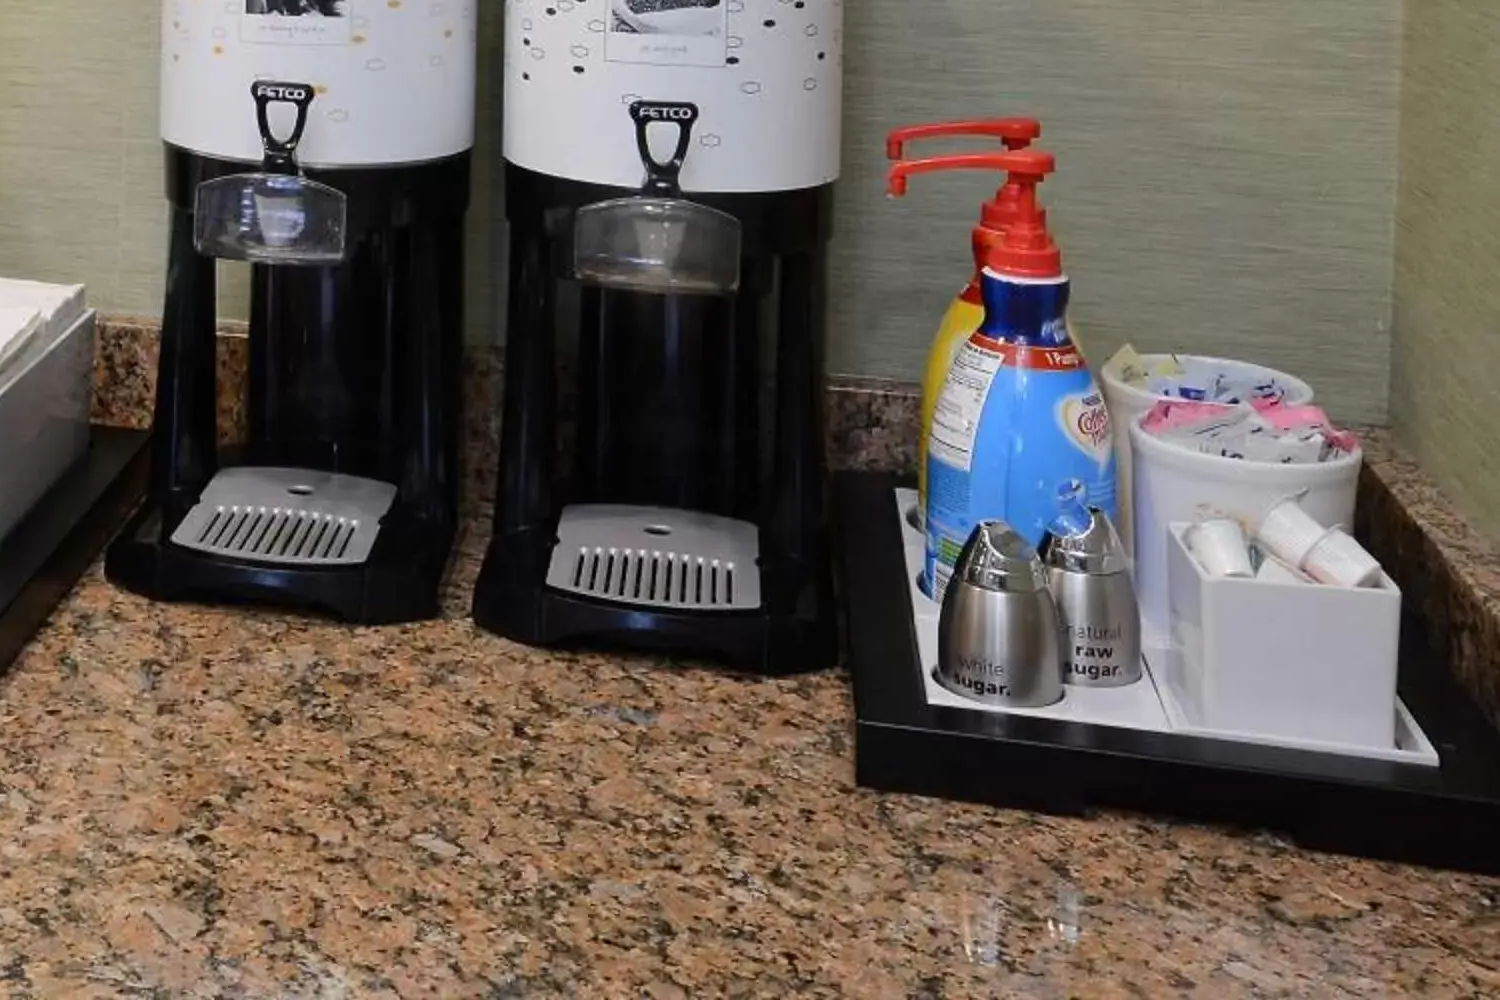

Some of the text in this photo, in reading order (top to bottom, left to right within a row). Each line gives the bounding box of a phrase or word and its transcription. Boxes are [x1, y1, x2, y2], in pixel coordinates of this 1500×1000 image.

[257, 85, 306, 99] FETCO
[639, 106, 693, 119] FETCO
[1065, 622, 1122, 641] natural
[1075, 645, 1113, 659] raw
[958, 655, 1005, 676] white
[1064, 661, 1123, 681] sugar.
[954, 672, 1011, 697] sugar.
